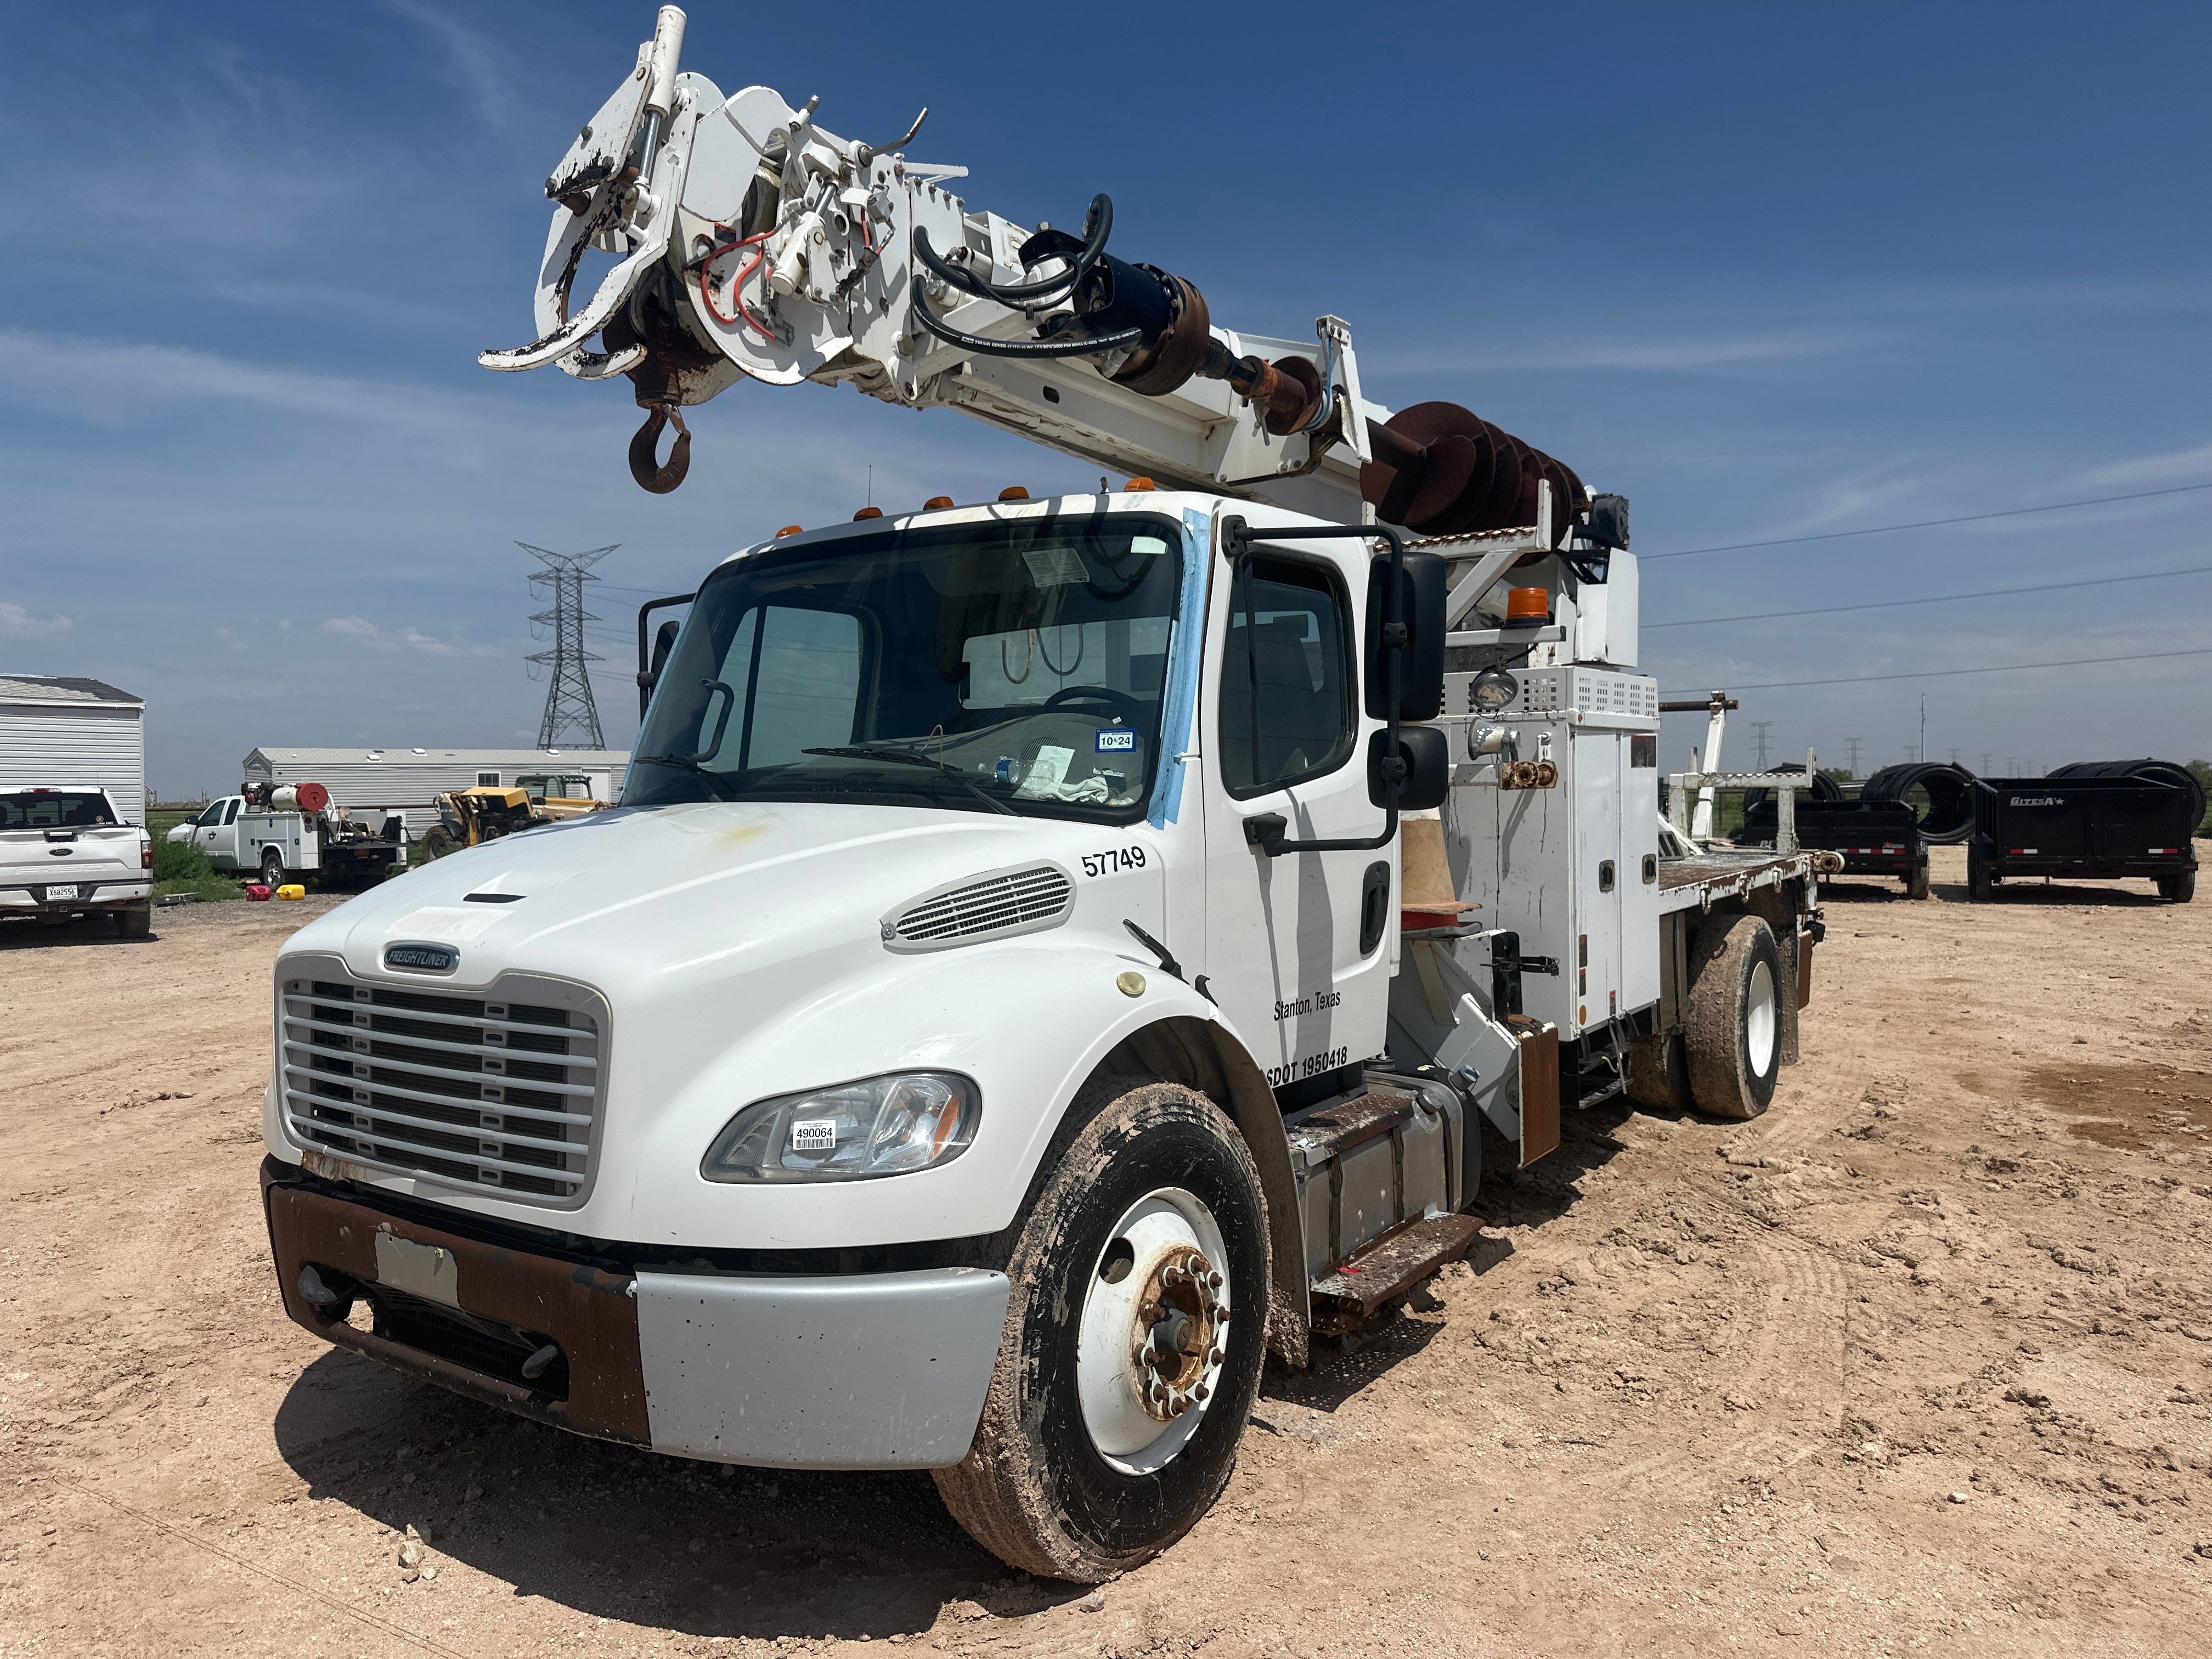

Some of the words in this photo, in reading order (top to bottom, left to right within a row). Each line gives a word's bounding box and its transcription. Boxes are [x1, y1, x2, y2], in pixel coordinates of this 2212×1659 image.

[1101, 737, 1113, 746] 10
[1118, 736, 1131, 745] 24
[1081, 845, 1146, 877] 57749
[388, 950, 449, 967] FREIGHTLINER
[1273, 998, 1312, 1022] Stanton,
[1315, 991, 1340, 1011] Texas
[1267, 1061, 1298, 1087] SDOT
[1302, 1046, 1347, 1077] 1950418
[797, 1127, 833, 1138] 490064
